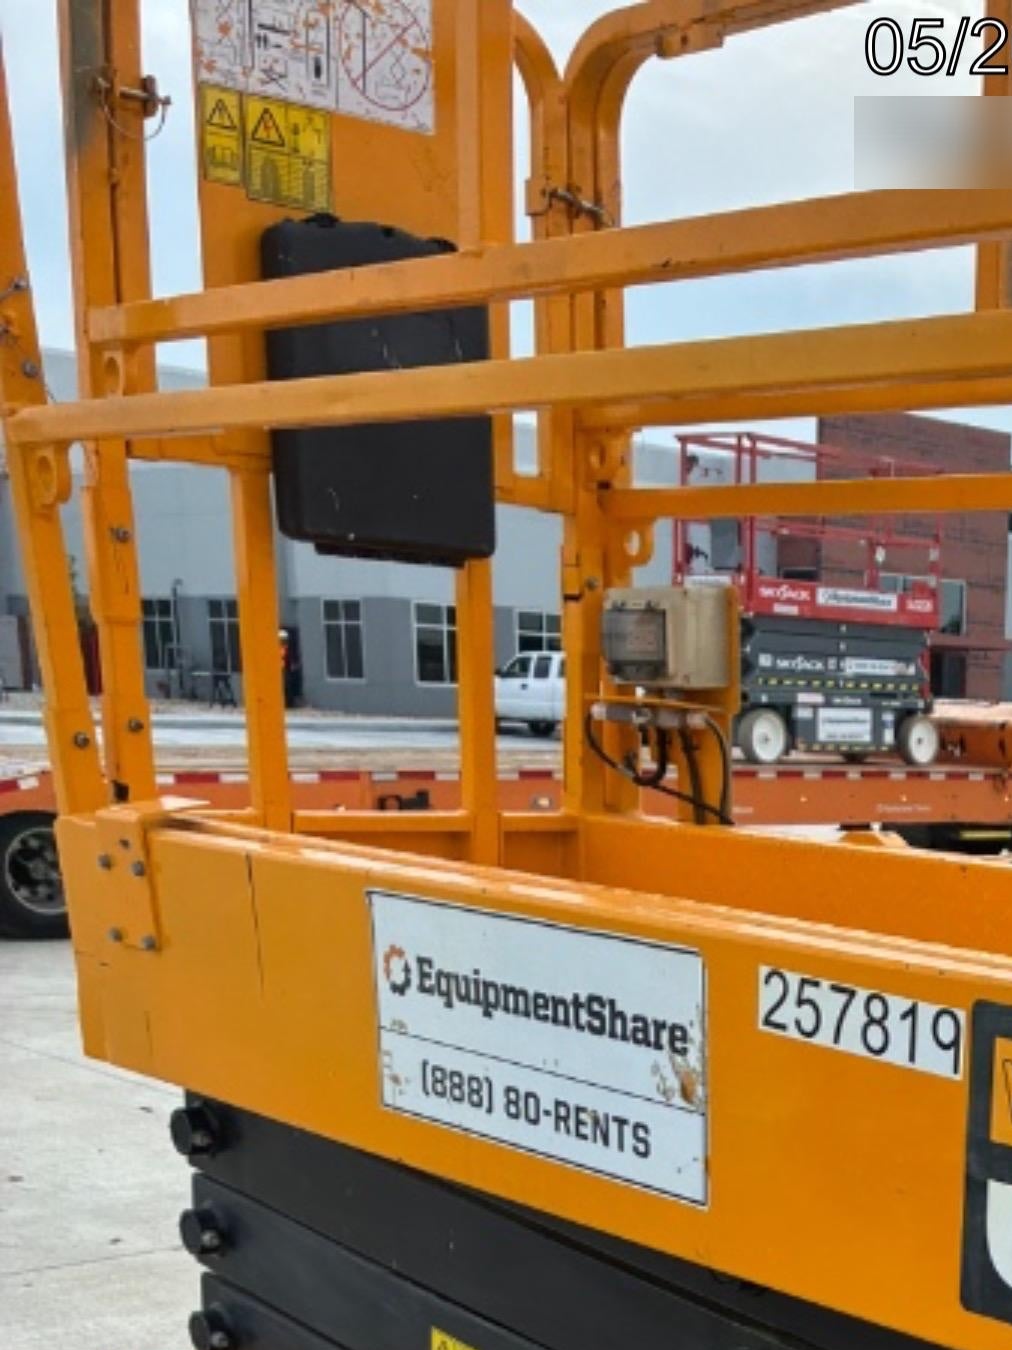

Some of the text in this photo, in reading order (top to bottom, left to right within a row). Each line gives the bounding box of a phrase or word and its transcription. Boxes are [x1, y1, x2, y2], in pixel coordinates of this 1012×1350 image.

[415, 955, 692, 1056] EquipmentShare
[761, 968, 962, 1076] 257819
[421, 1057, 652, 1160] (888) 80-RENTS
